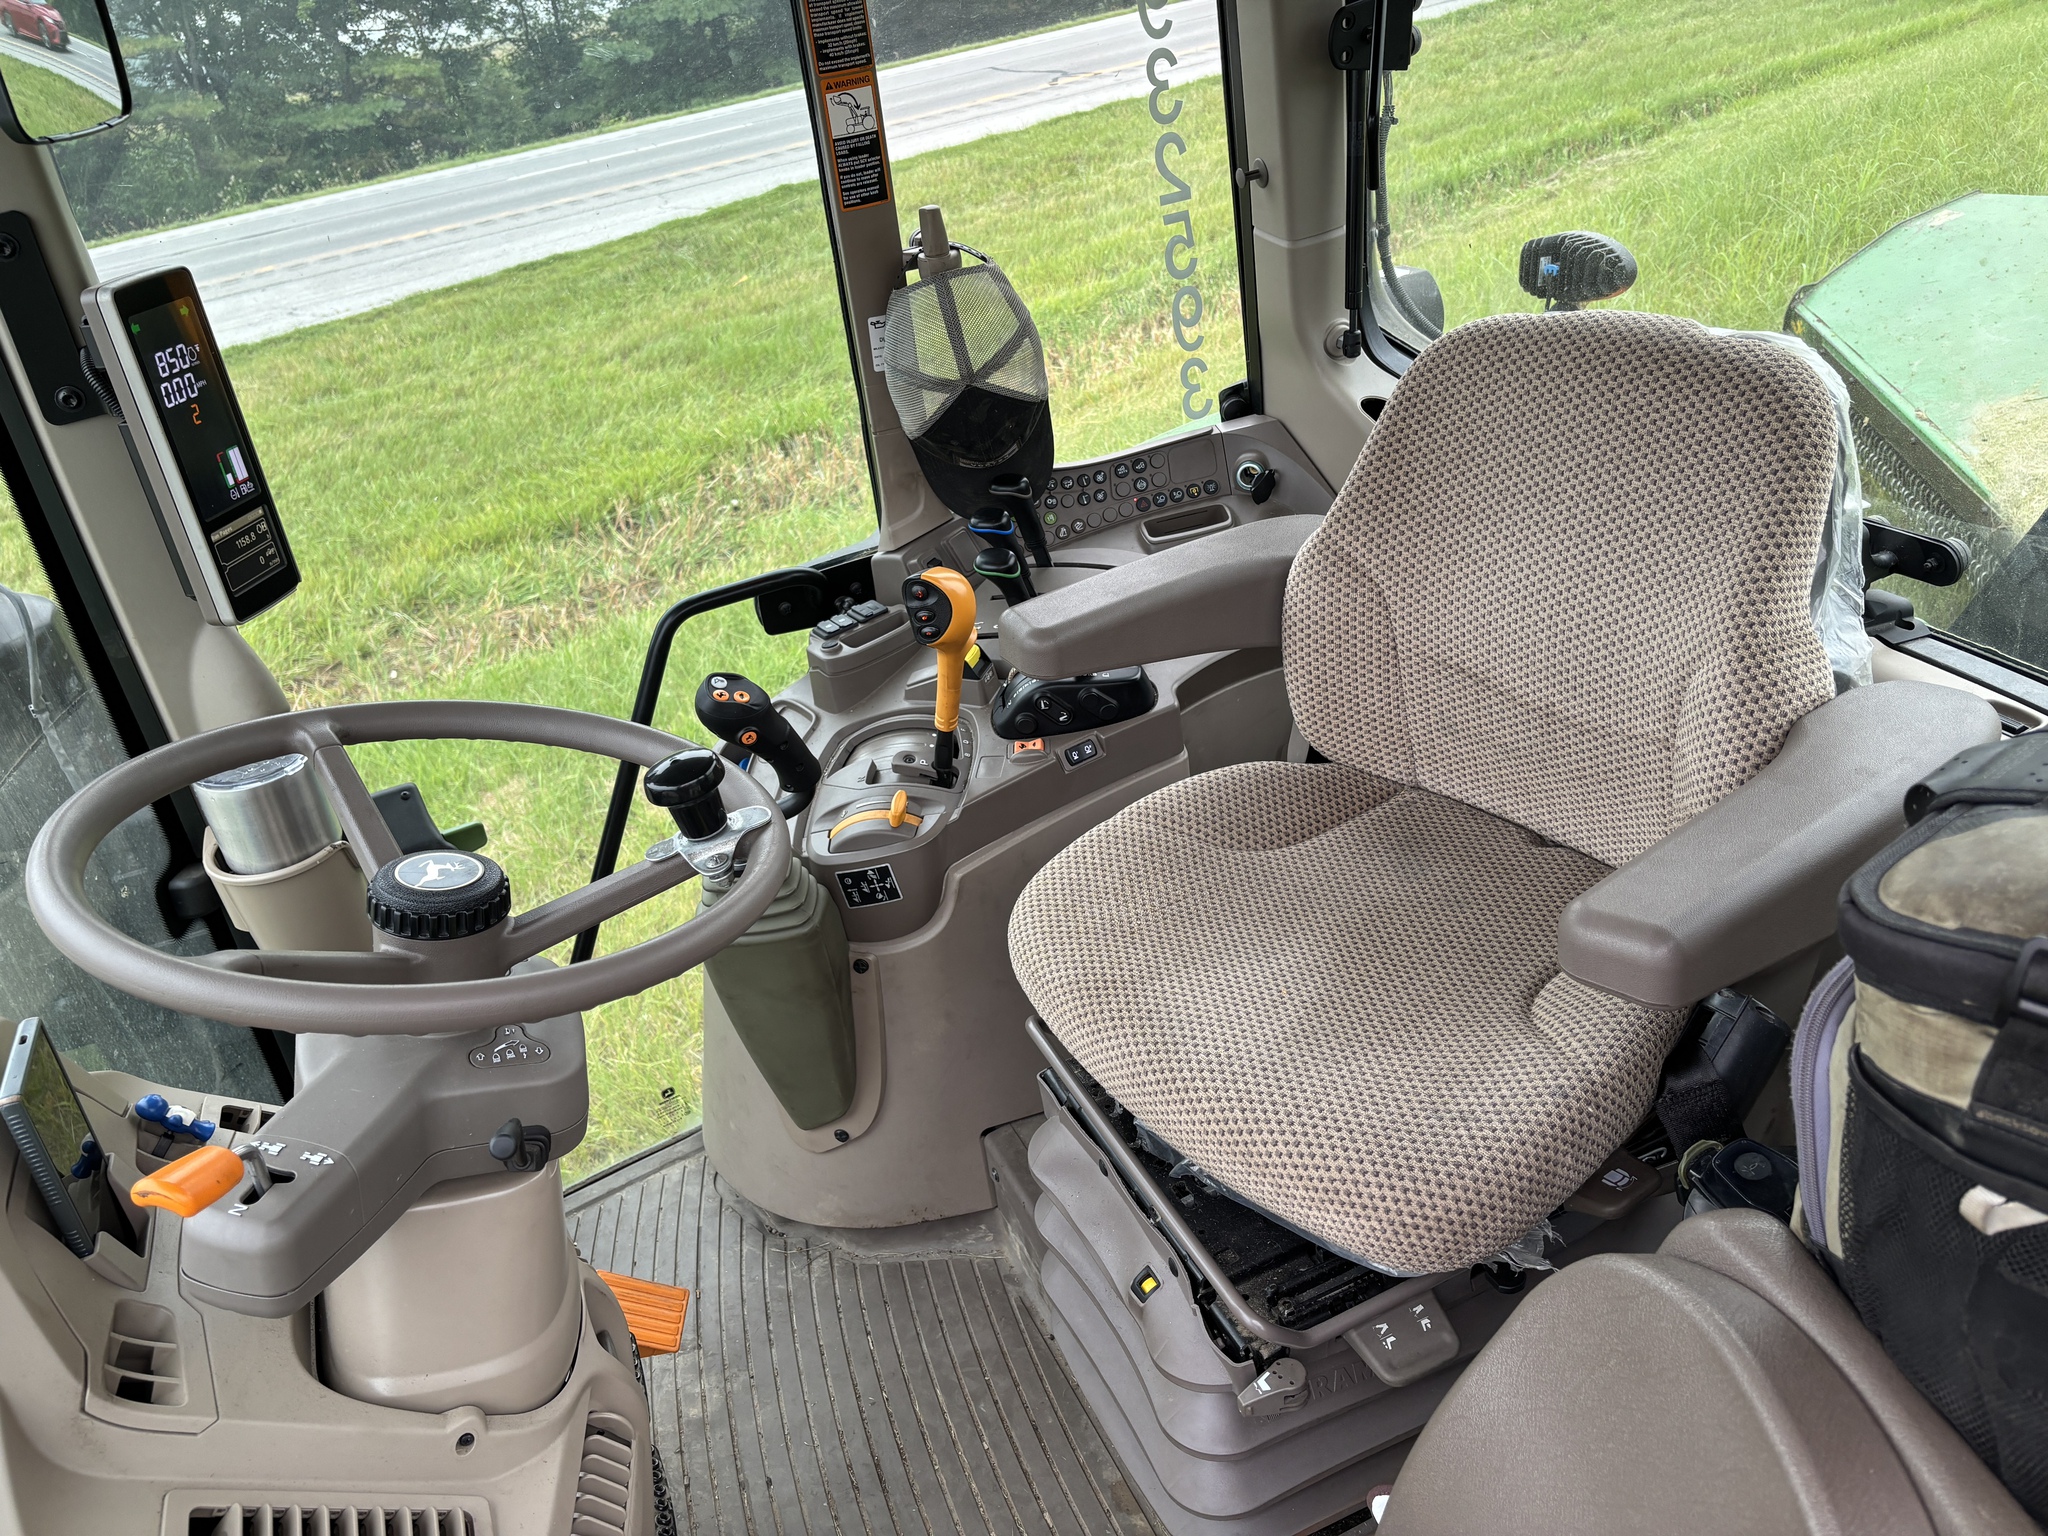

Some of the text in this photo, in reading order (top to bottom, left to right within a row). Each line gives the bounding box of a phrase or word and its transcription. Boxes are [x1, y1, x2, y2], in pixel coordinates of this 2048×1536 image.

[833, 75, 870, 89] WARNING
[155, 344, 190, 378] 850
[160, 372, 207, 408] 0.00 MPH
[191, 404, 202, 424] 2
[219, 526, 233, 538] Pages
[236, 532, 256, 548] 1158.8
